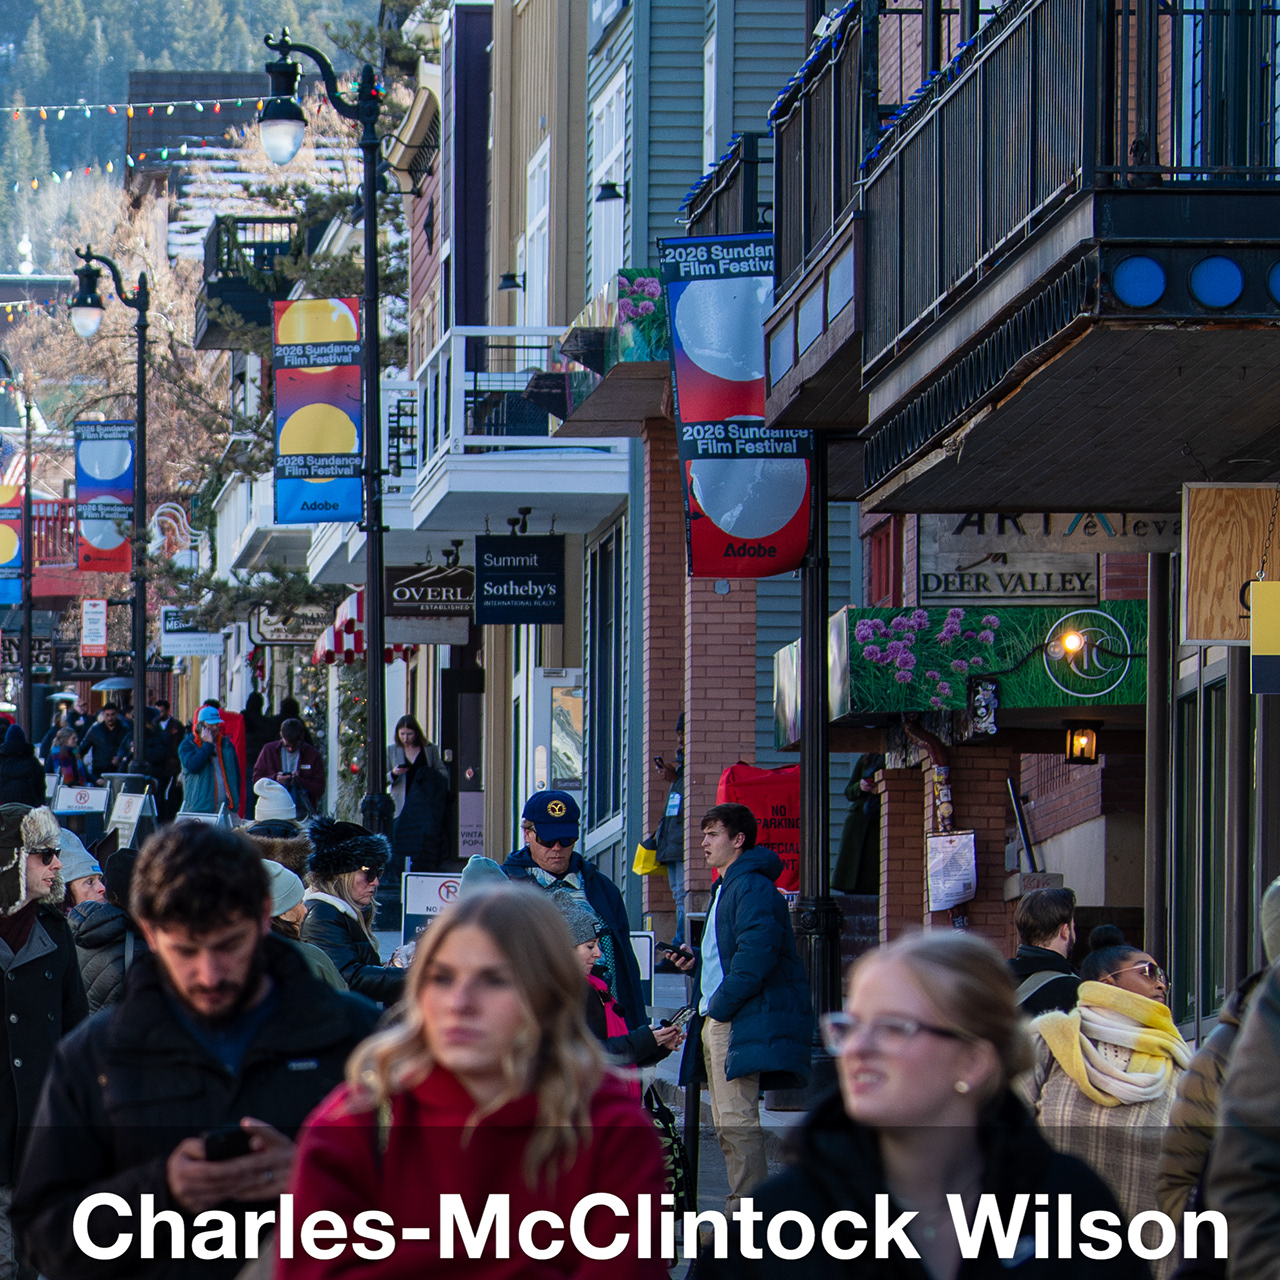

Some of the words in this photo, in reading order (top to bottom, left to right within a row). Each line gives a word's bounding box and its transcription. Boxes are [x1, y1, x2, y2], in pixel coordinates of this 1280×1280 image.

[665, 247, 708, 263] 2026
[711, 243, 774, 260] Sundan
[680, 261, 716, 277] Film
[720, 258, 775, 274] Festiva
[276, 345, 303, 356] 2026
[306, 344, 361, 354] Sundance
[284, 355, 308, 366] Film
[311, 353, 352, 365] Festival
[76, 425, 95, 433] 2026
[96, 425, 135, 433] Sundance
[98, 431, 129, 439] Festival
[683, 425, 725, 440] 2026
[728, 424, 808, 439] Sundance
[697, 440, 732, 454] Film
[736, 439, 797, 454] Festival
[277, 456, 305, 466] 2026
[306, 456, 362, 466] Sundance
[285, 466, 309, 476] Film
[311, 465, 354, 475] Festival
[97, 504, 134, 512] Sundance
[301, 500, 340, 511] Adobe
[100, 511, 129, 519] Festival
[723, 543, 777, 558] Adobe
[484, 553, 539, 567] Summit
[921, 572, 990, 593] DEER
[997, 572, 1092, 593] VALLEY
[393, 587, 475, 601] OVERL
[483, 580, 557, 598] Sotheby's
[772, 805, 787, 817] NO
[756, 818, 800, 829] PARKING
[757, 843, 800, 854] PECIAL
